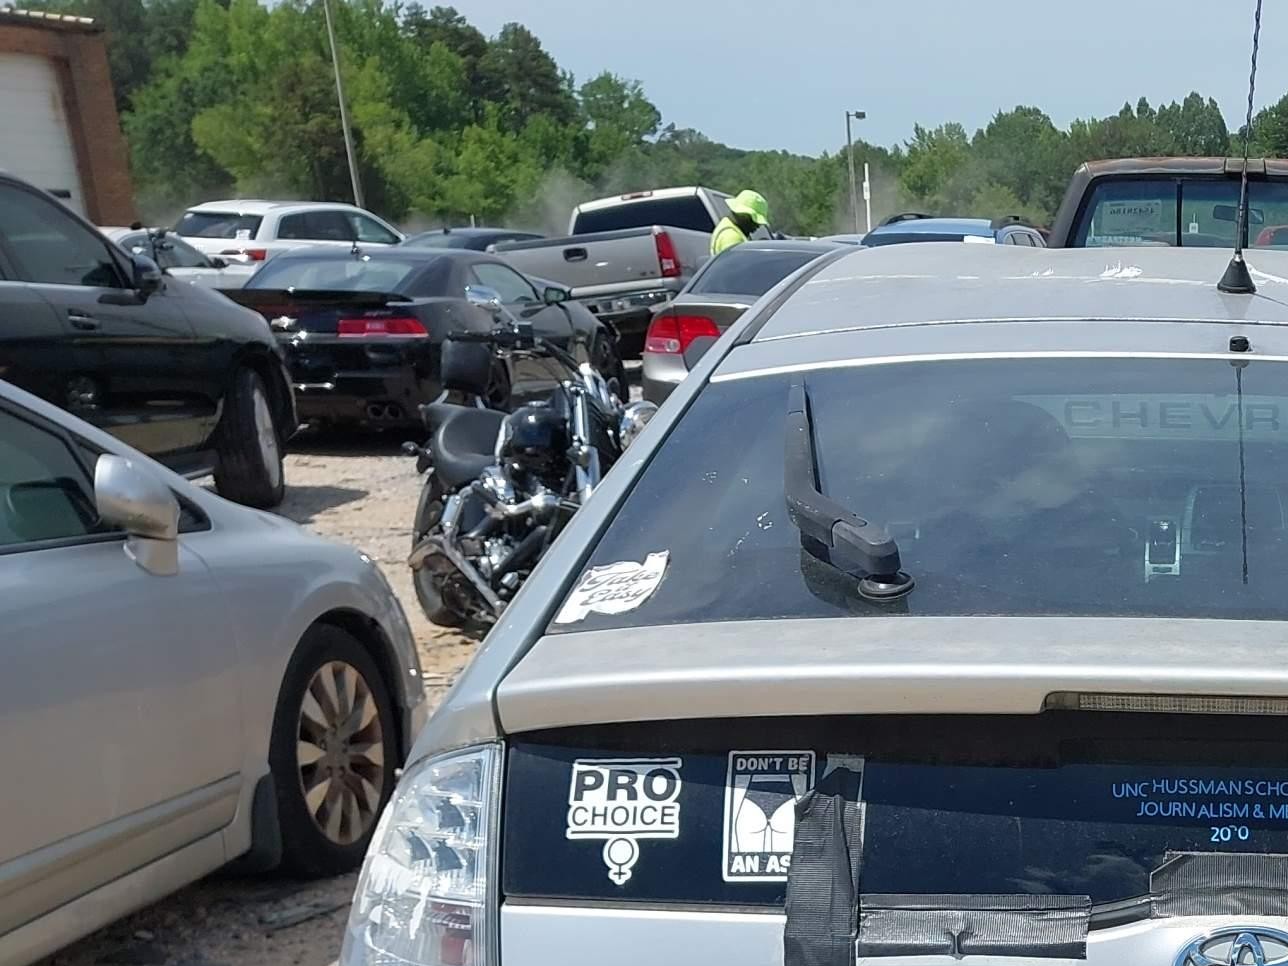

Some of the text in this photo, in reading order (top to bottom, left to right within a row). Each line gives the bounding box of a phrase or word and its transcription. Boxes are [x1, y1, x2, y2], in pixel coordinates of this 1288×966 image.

[736, 757, 808, 771] DON'T BE
[574, 768, 678, 801] PRO
[1112, 782, 1149, 798] UNC
[1152, 779, 1242, 796] HUSSMAN
[572, 805, 676, 827] CHOICE
[1137, 801, 1249, 818] JOURNALISM
[1252, 803, 1265, 818] &
[730, 854, 791, 873] AN AS
